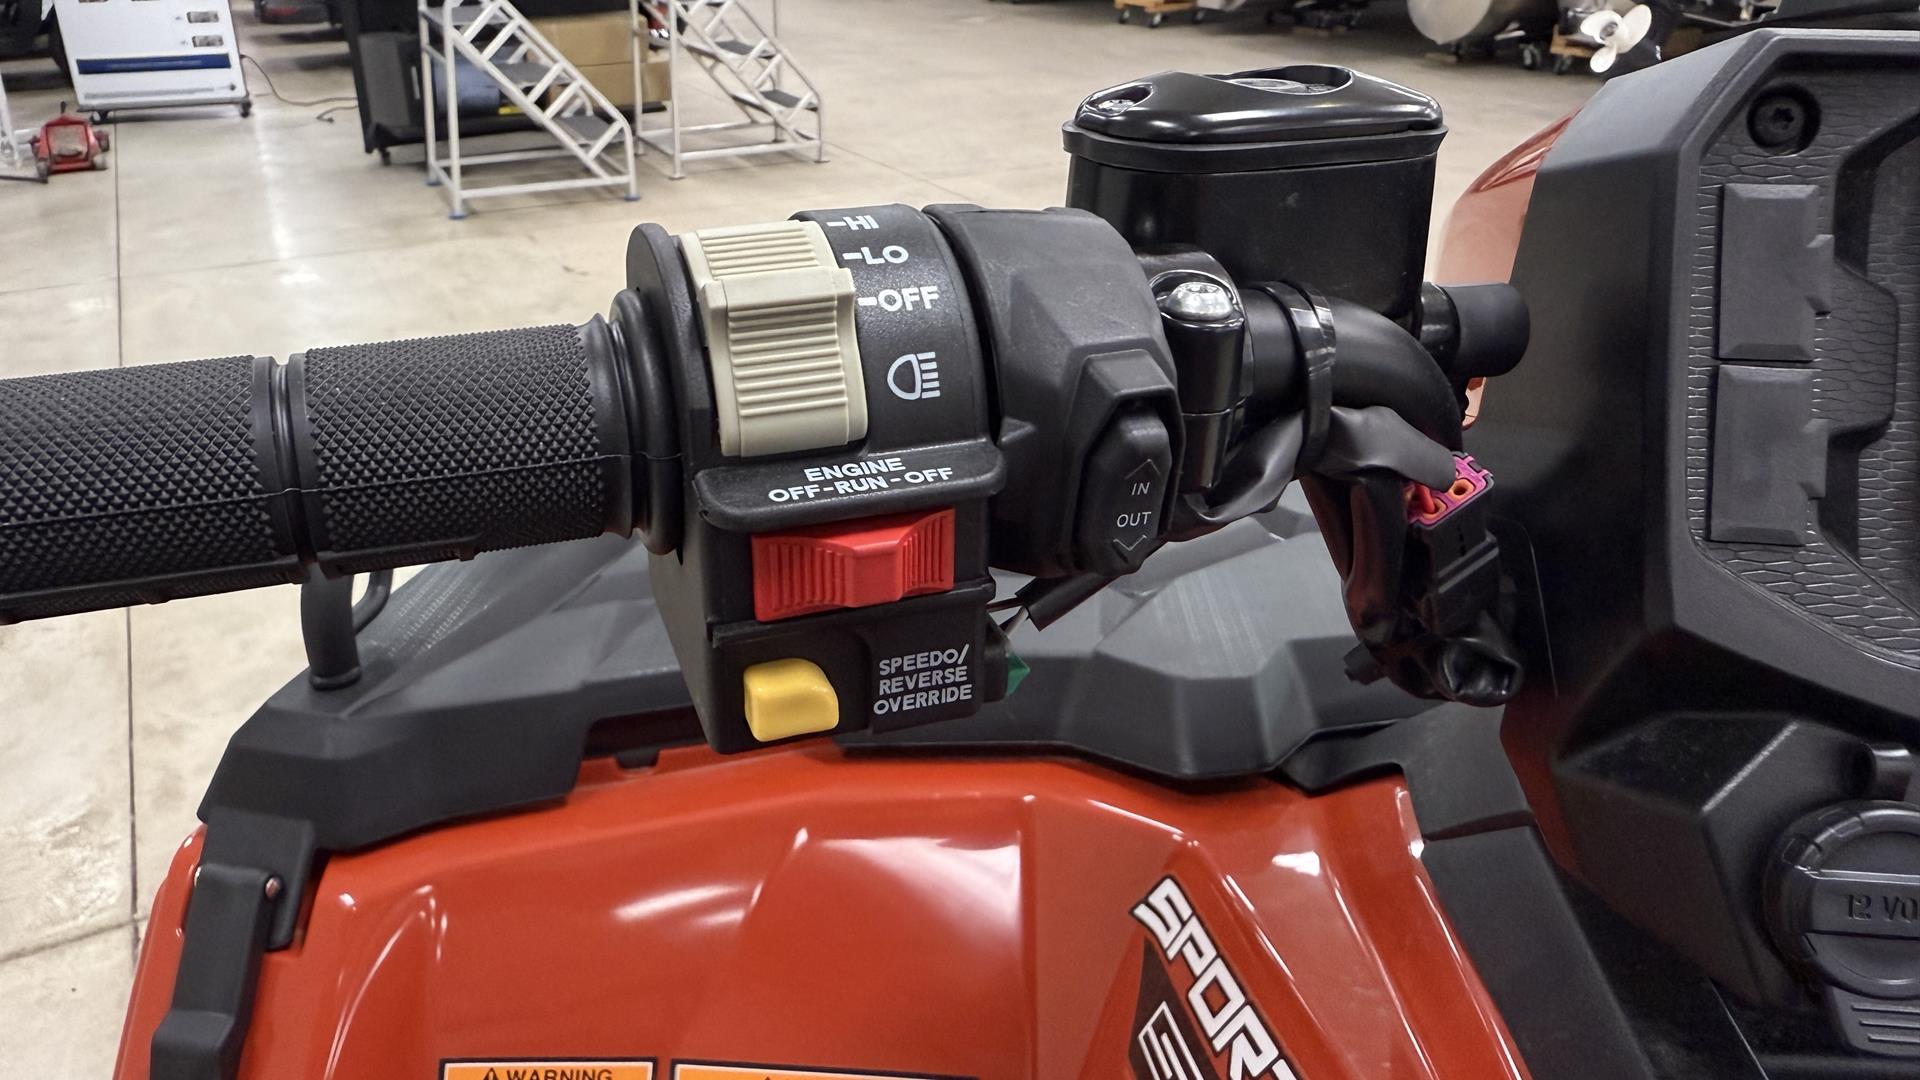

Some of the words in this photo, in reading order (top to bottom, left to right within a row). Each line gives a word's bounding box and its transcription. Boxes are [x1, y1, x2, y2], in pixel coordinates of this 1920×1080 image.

[804, 458, 906, 482] ENGINE
[1131, 482, 1151, 496] IN
[1116, 511, 1152, 528] OUT
[879, 643, 970, 676] SPEEDO/
[879, 666, 968, 696] REVERSE
[873, 684, 973, 715] OVERRIDE
[1848, 895, 1872, 919] 12
